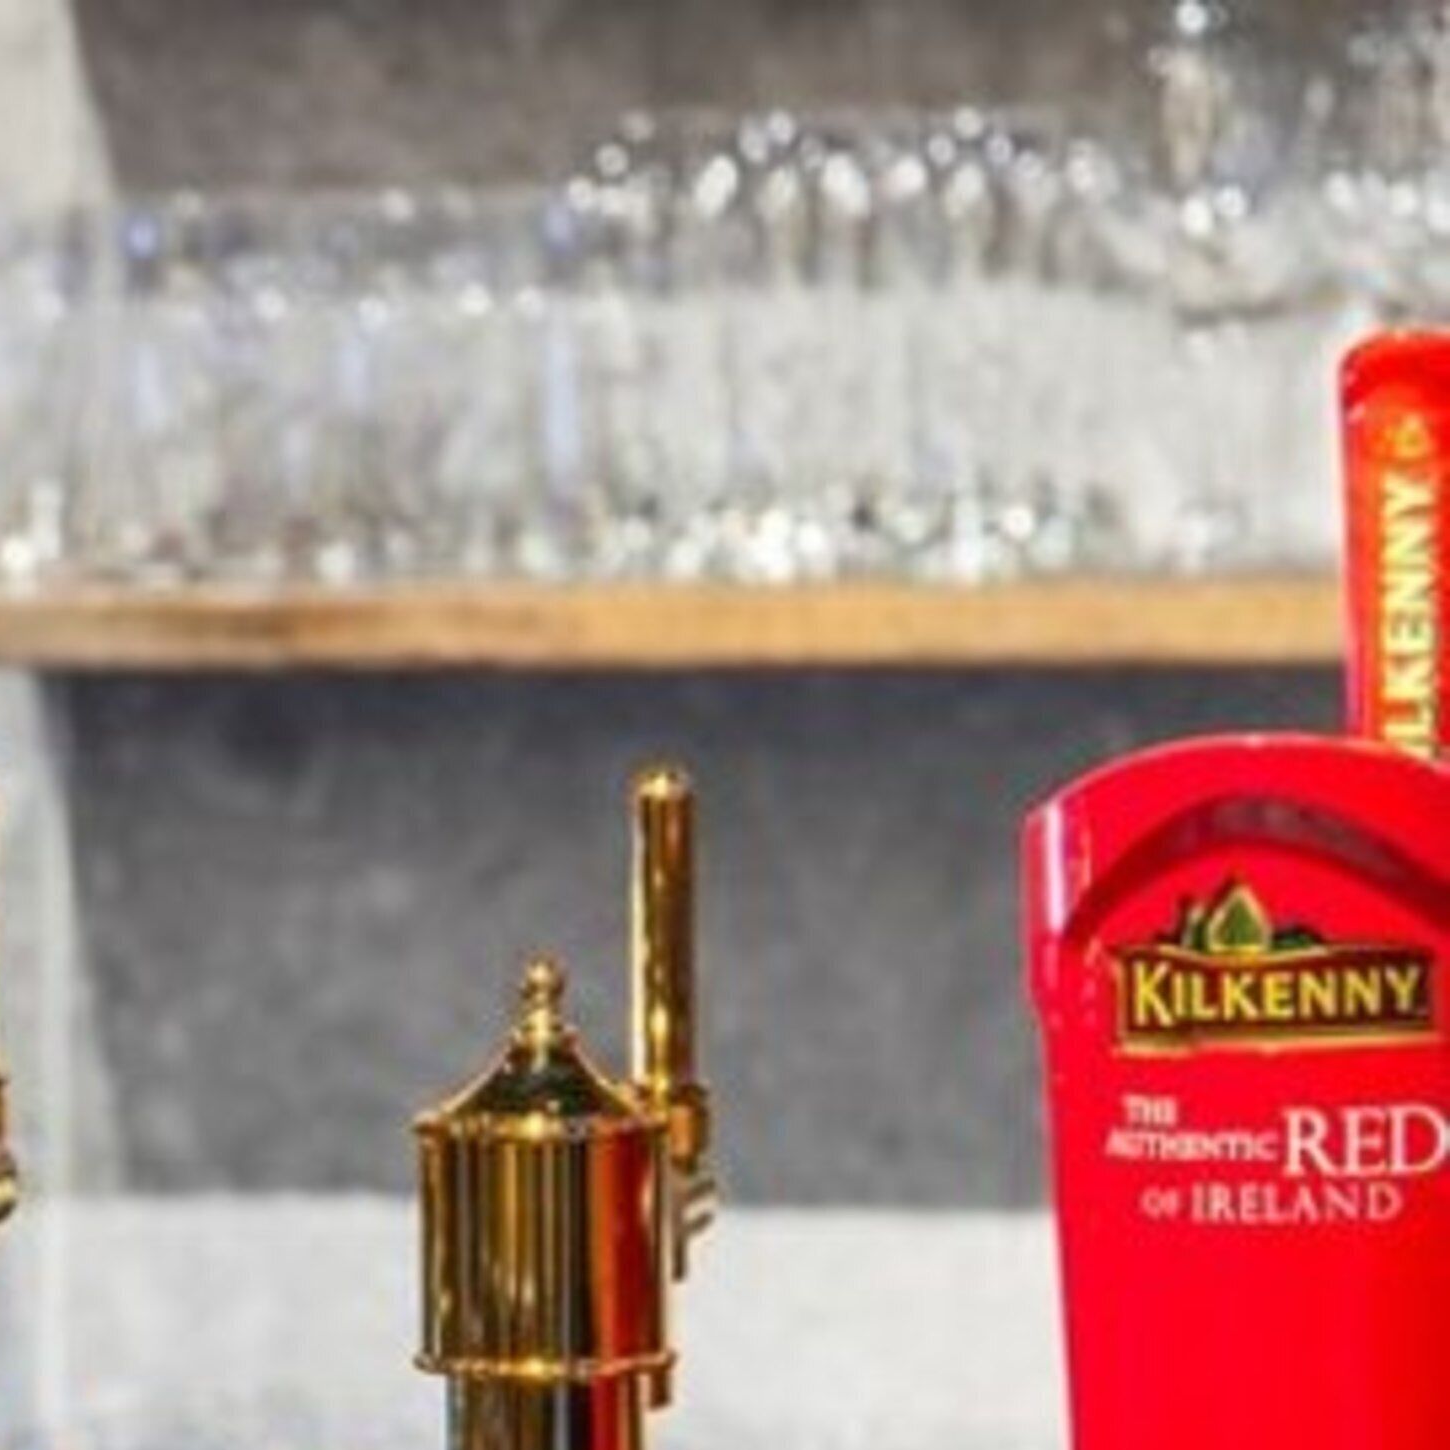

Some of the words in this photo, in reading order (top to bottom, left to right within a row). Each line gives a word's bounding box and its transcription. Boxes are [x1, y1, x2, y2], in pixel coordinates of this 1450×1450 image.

[1133, 960, 1421, 1027] KILKENNY
[1282, 1103, 1450, 1177] RED
[1191, 1182, 1403, 1224] IRELAND
